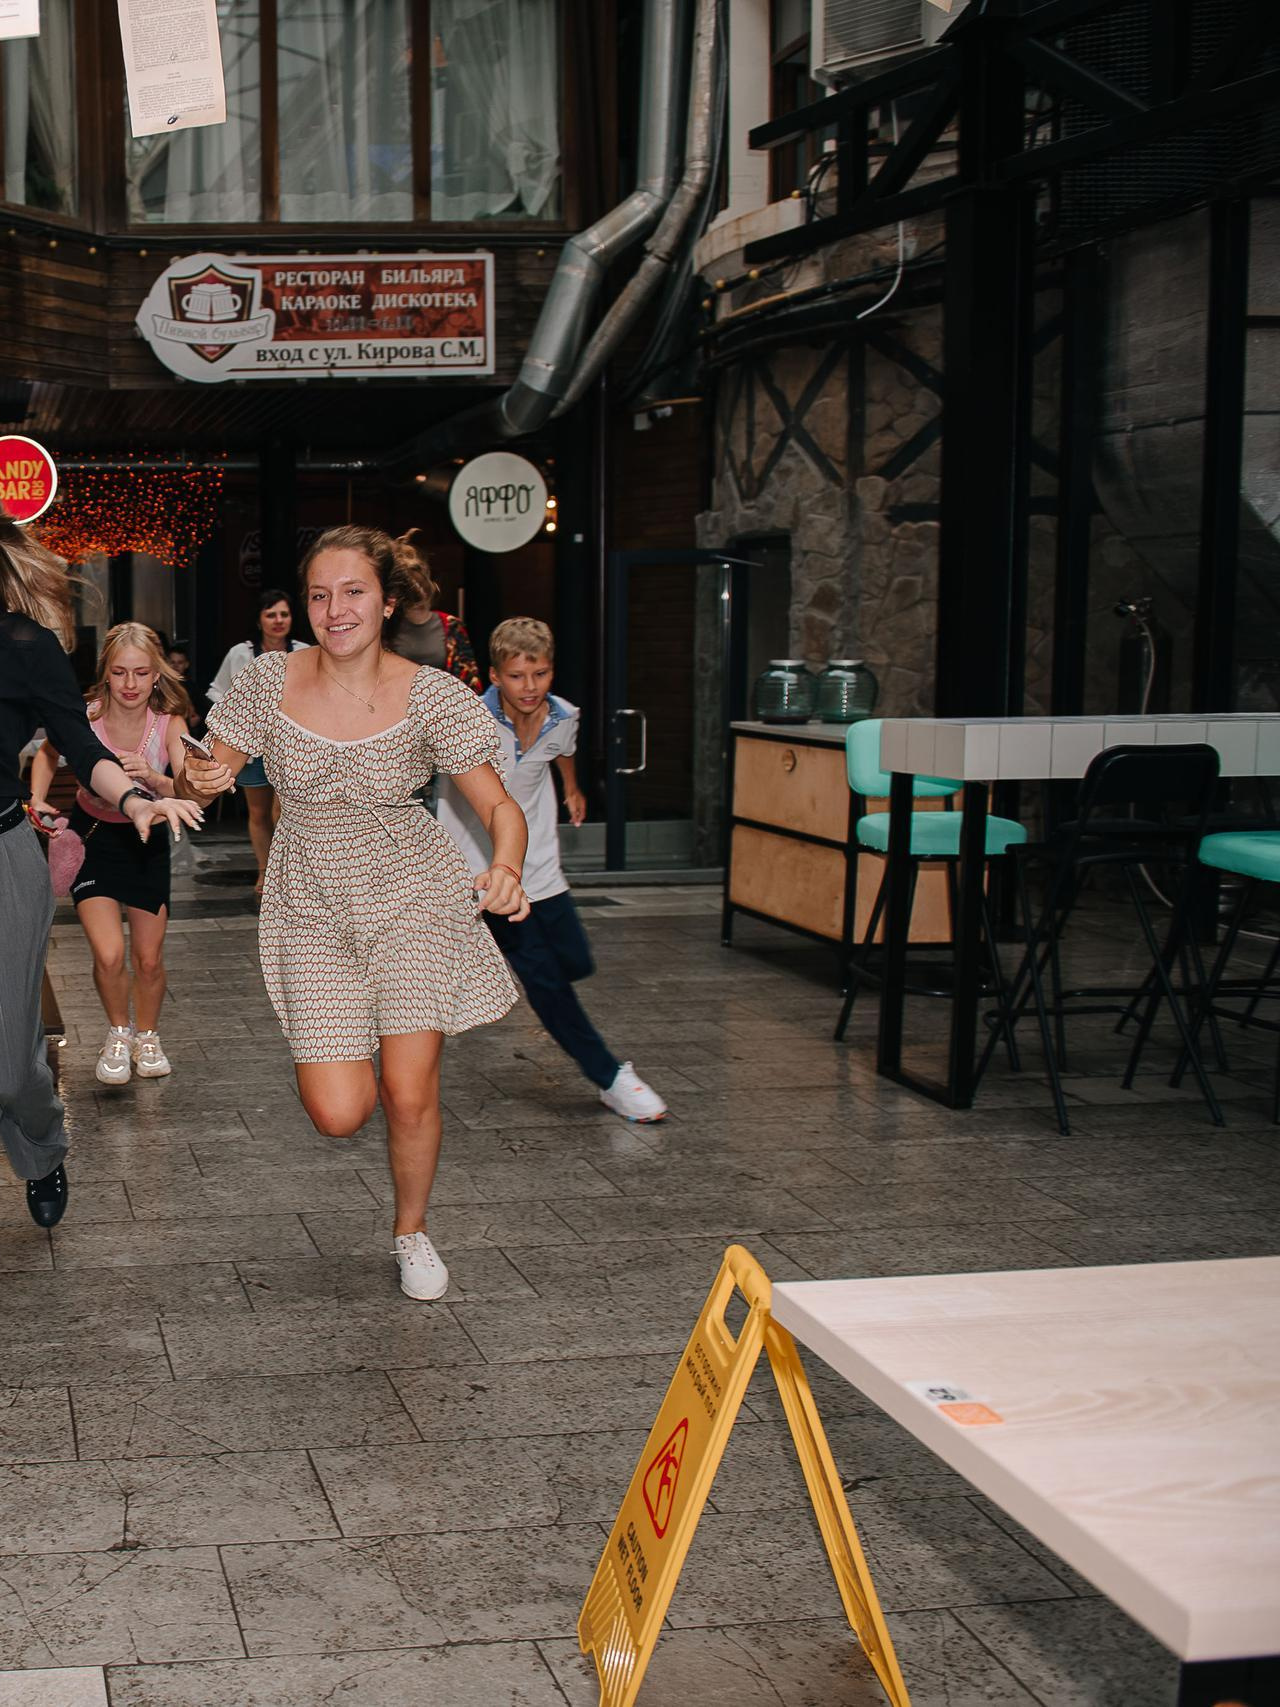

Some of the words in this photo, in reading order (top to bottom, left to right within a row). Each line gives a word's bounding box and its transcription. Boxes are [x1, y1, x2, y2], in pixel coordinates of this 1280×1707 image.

[274, 269, 366, 287] РЕСТОРАН
[380, 268, 466, 286] БИЛЬЯРД
[280, 294, 362, 312] КАРАОКЕ
[371, 292, 478, 311] ДИСКОТЕКА
[255, 346, 304, 364] вход
[308, 348, 319, 361] с
[323, 346, 352, 365] ул.
[356, 342, 436, 365] Кирова
[439, 340, 481, 359] С.М.
[627, 1520, 649, 1585] CAUTION
[617, 1532, 630, 1567] WET
[626, 1562, 644, 1615] FLOOR
